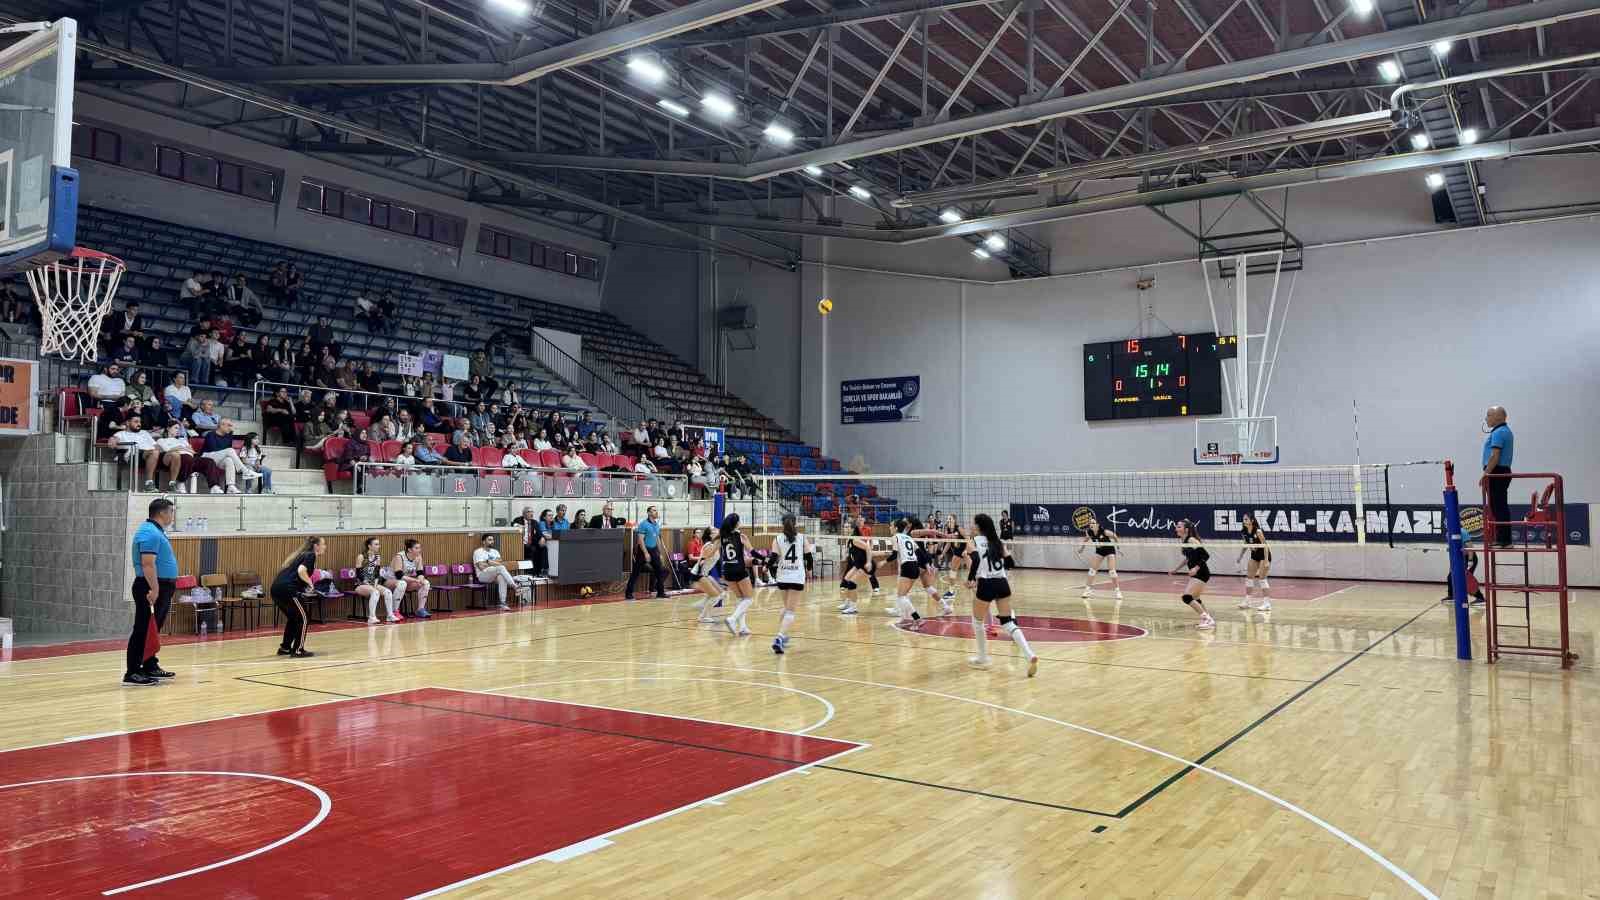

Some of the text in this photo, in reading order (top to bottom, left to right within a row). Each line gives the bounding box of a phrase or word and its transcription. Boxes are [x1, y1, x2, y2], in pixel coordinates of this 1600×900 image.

[1127, 340, 1139, 353] 15
[1178, 335, 1185, 349] 7
[1135, 363, 1169, 378] 15 14
[1115, 380, 1122, 391] 0
[1179, 375, 1186, 387] 0
[1106, 505, 1200, 533] Kadın
[1213, 509, 1244, 532] EL
[725, 543, 737, 560] 6
[784, 543, 799, 564] 4
[904, 541, 914, 557] 9
